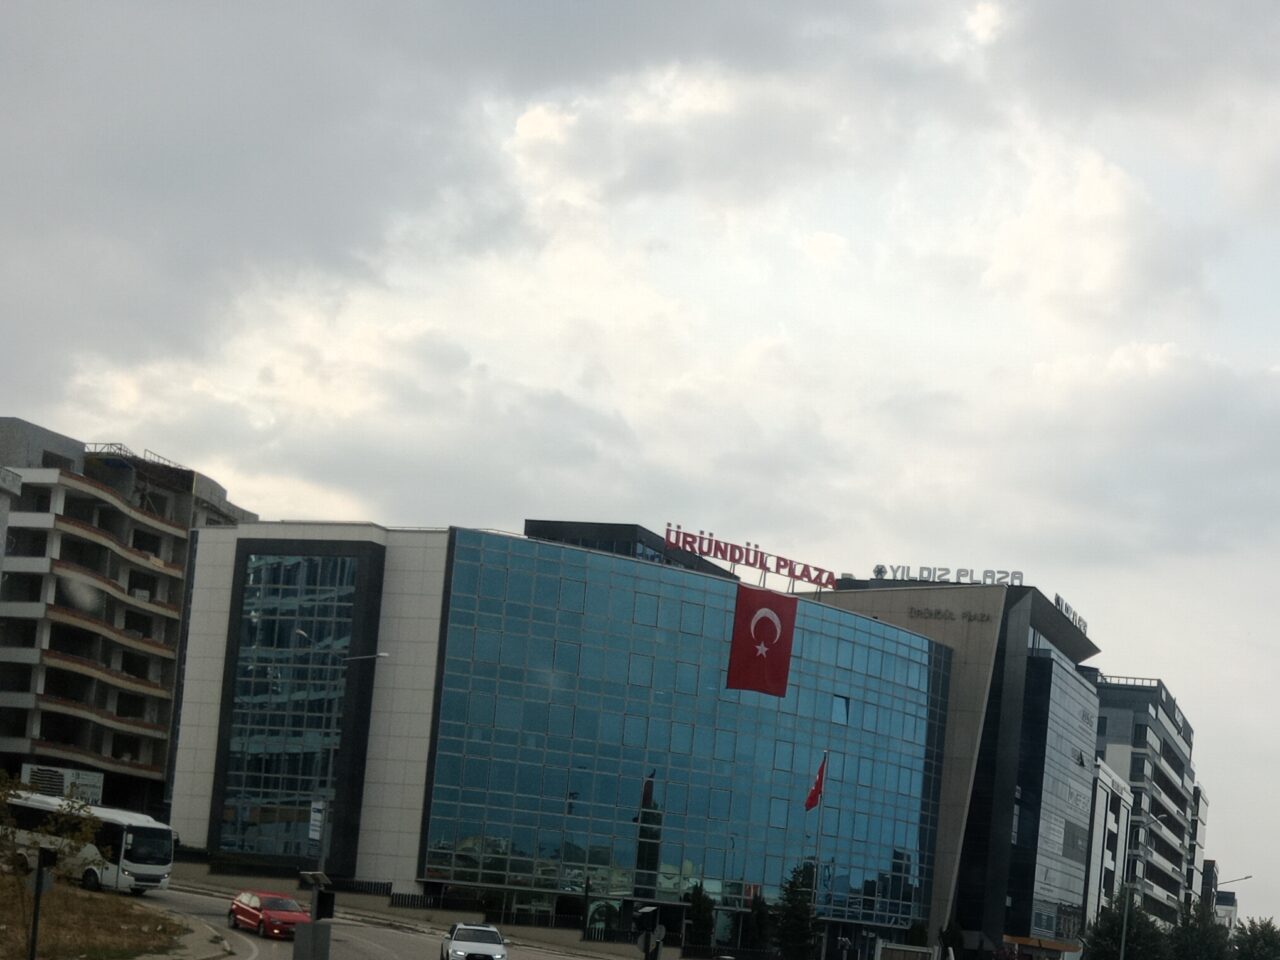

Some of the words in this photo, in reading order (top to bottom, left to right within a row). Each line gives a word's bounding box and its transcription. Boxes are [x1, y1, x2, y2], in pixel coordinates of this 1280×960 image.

[664, 522, 770, 572] ÜRÜNDÜL
[775, 555, 838, 590] PLAZA
[889, 565, 951, 583] YILDIZ
[956, 568, 1024, 586] PLAZA
